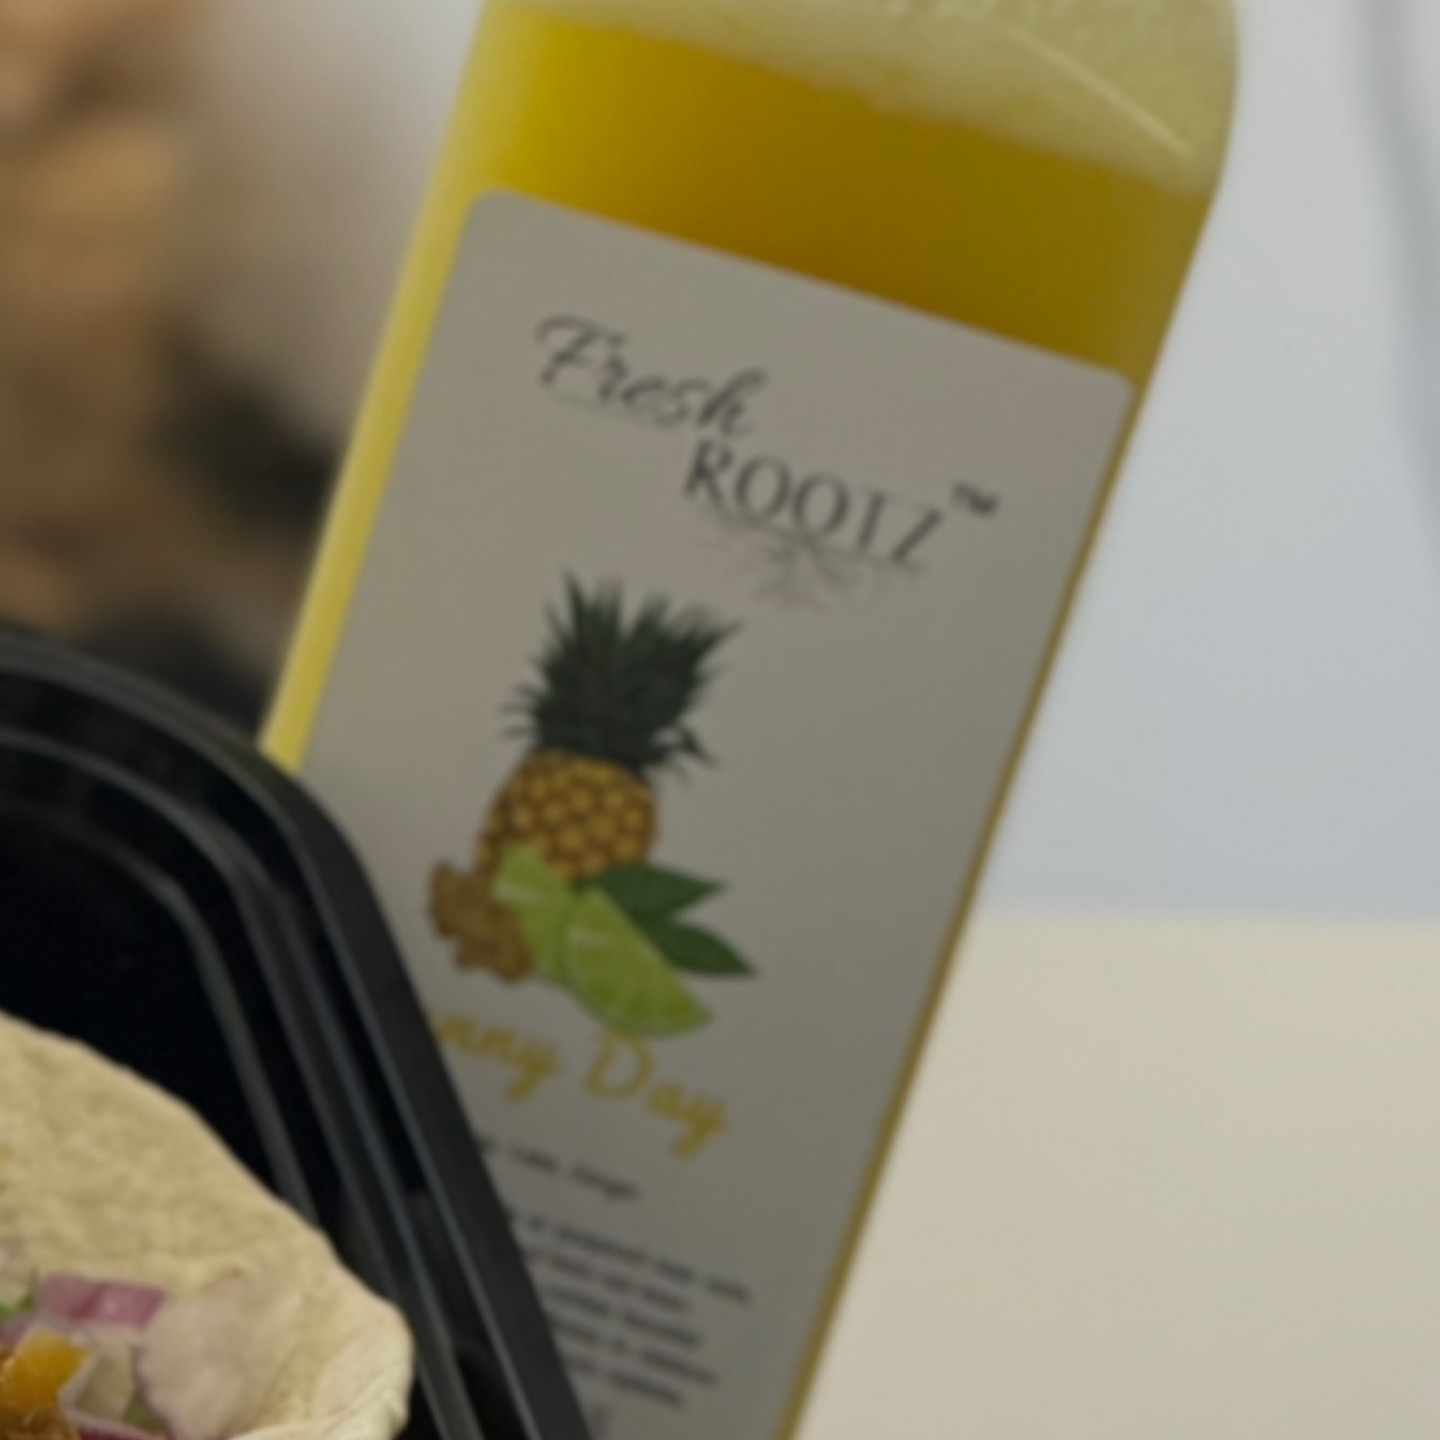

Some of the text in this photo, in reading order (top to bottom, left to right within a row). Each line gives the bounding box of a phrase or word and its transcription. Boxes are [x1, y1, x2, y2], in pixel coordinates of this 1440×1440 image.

[534, 313, 768, 440] Fresh
[426, 1008, 728, 1161] nny Day
